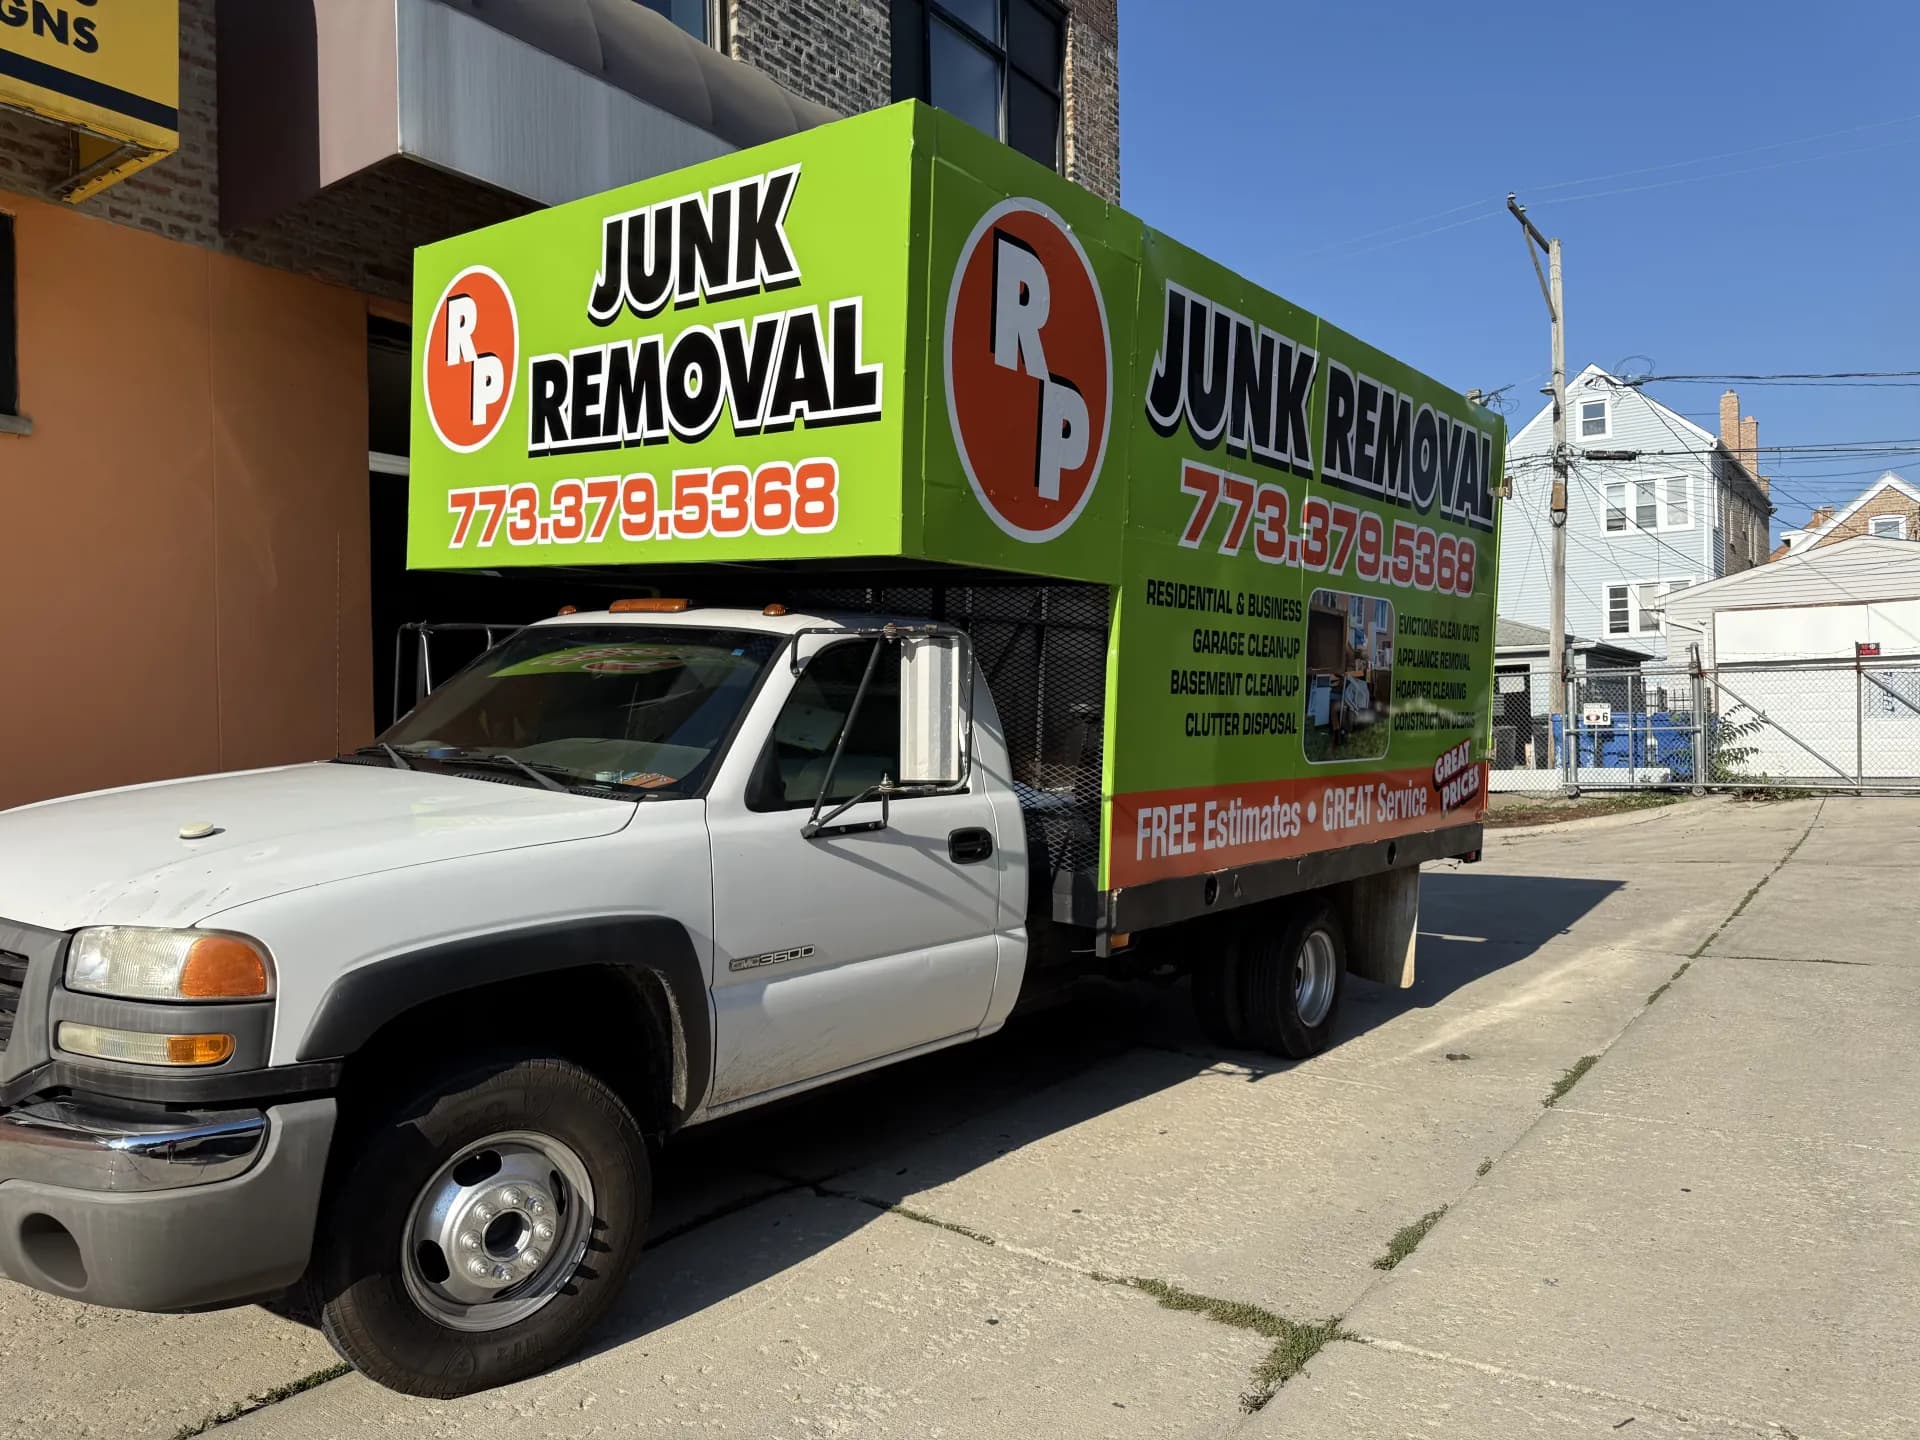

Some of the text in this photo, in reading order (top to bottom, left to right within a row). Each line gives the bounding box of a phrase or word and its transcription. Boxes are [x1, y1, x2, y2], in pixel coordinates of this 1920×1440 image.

[587, 162, 802, 327] JUNK
[528, 296, 883, 458] REMOVAL
[1145, 278, 1495, 533] JUNK REMOVAL
[448, 456, 839, 549] 773.379.5368
[1177, 458, 1477, 598] 773.379.5368
[1146, 578, 1302, 622] RESIDENTIAL & BUSINESS
[1192, 628, 1300, 660] GARAGE CLEAN-UP
[1399, 615, 1439, 638] EVICTIONS
[1439, 620, 1461, 640] CLEAN
[1397, 647, 1471, 672] APPLIANCE REMOVAL
[1170, 669, 1299, 697] BASEMENT CLEAN-UP
[1395, 680, 1467, 700] HOARDER CLEANING
[1185, 712, 1298, 737] CLUTTER DISPOSAL
[1394, 711, 1450, 731] CONSTRUCTION
[1434, 739, 1471, 783] GREAT
[1442, 764, 1480, 812] PRICES
[1136, 779, 1427, 861] FREE Estimates GREAT Service
